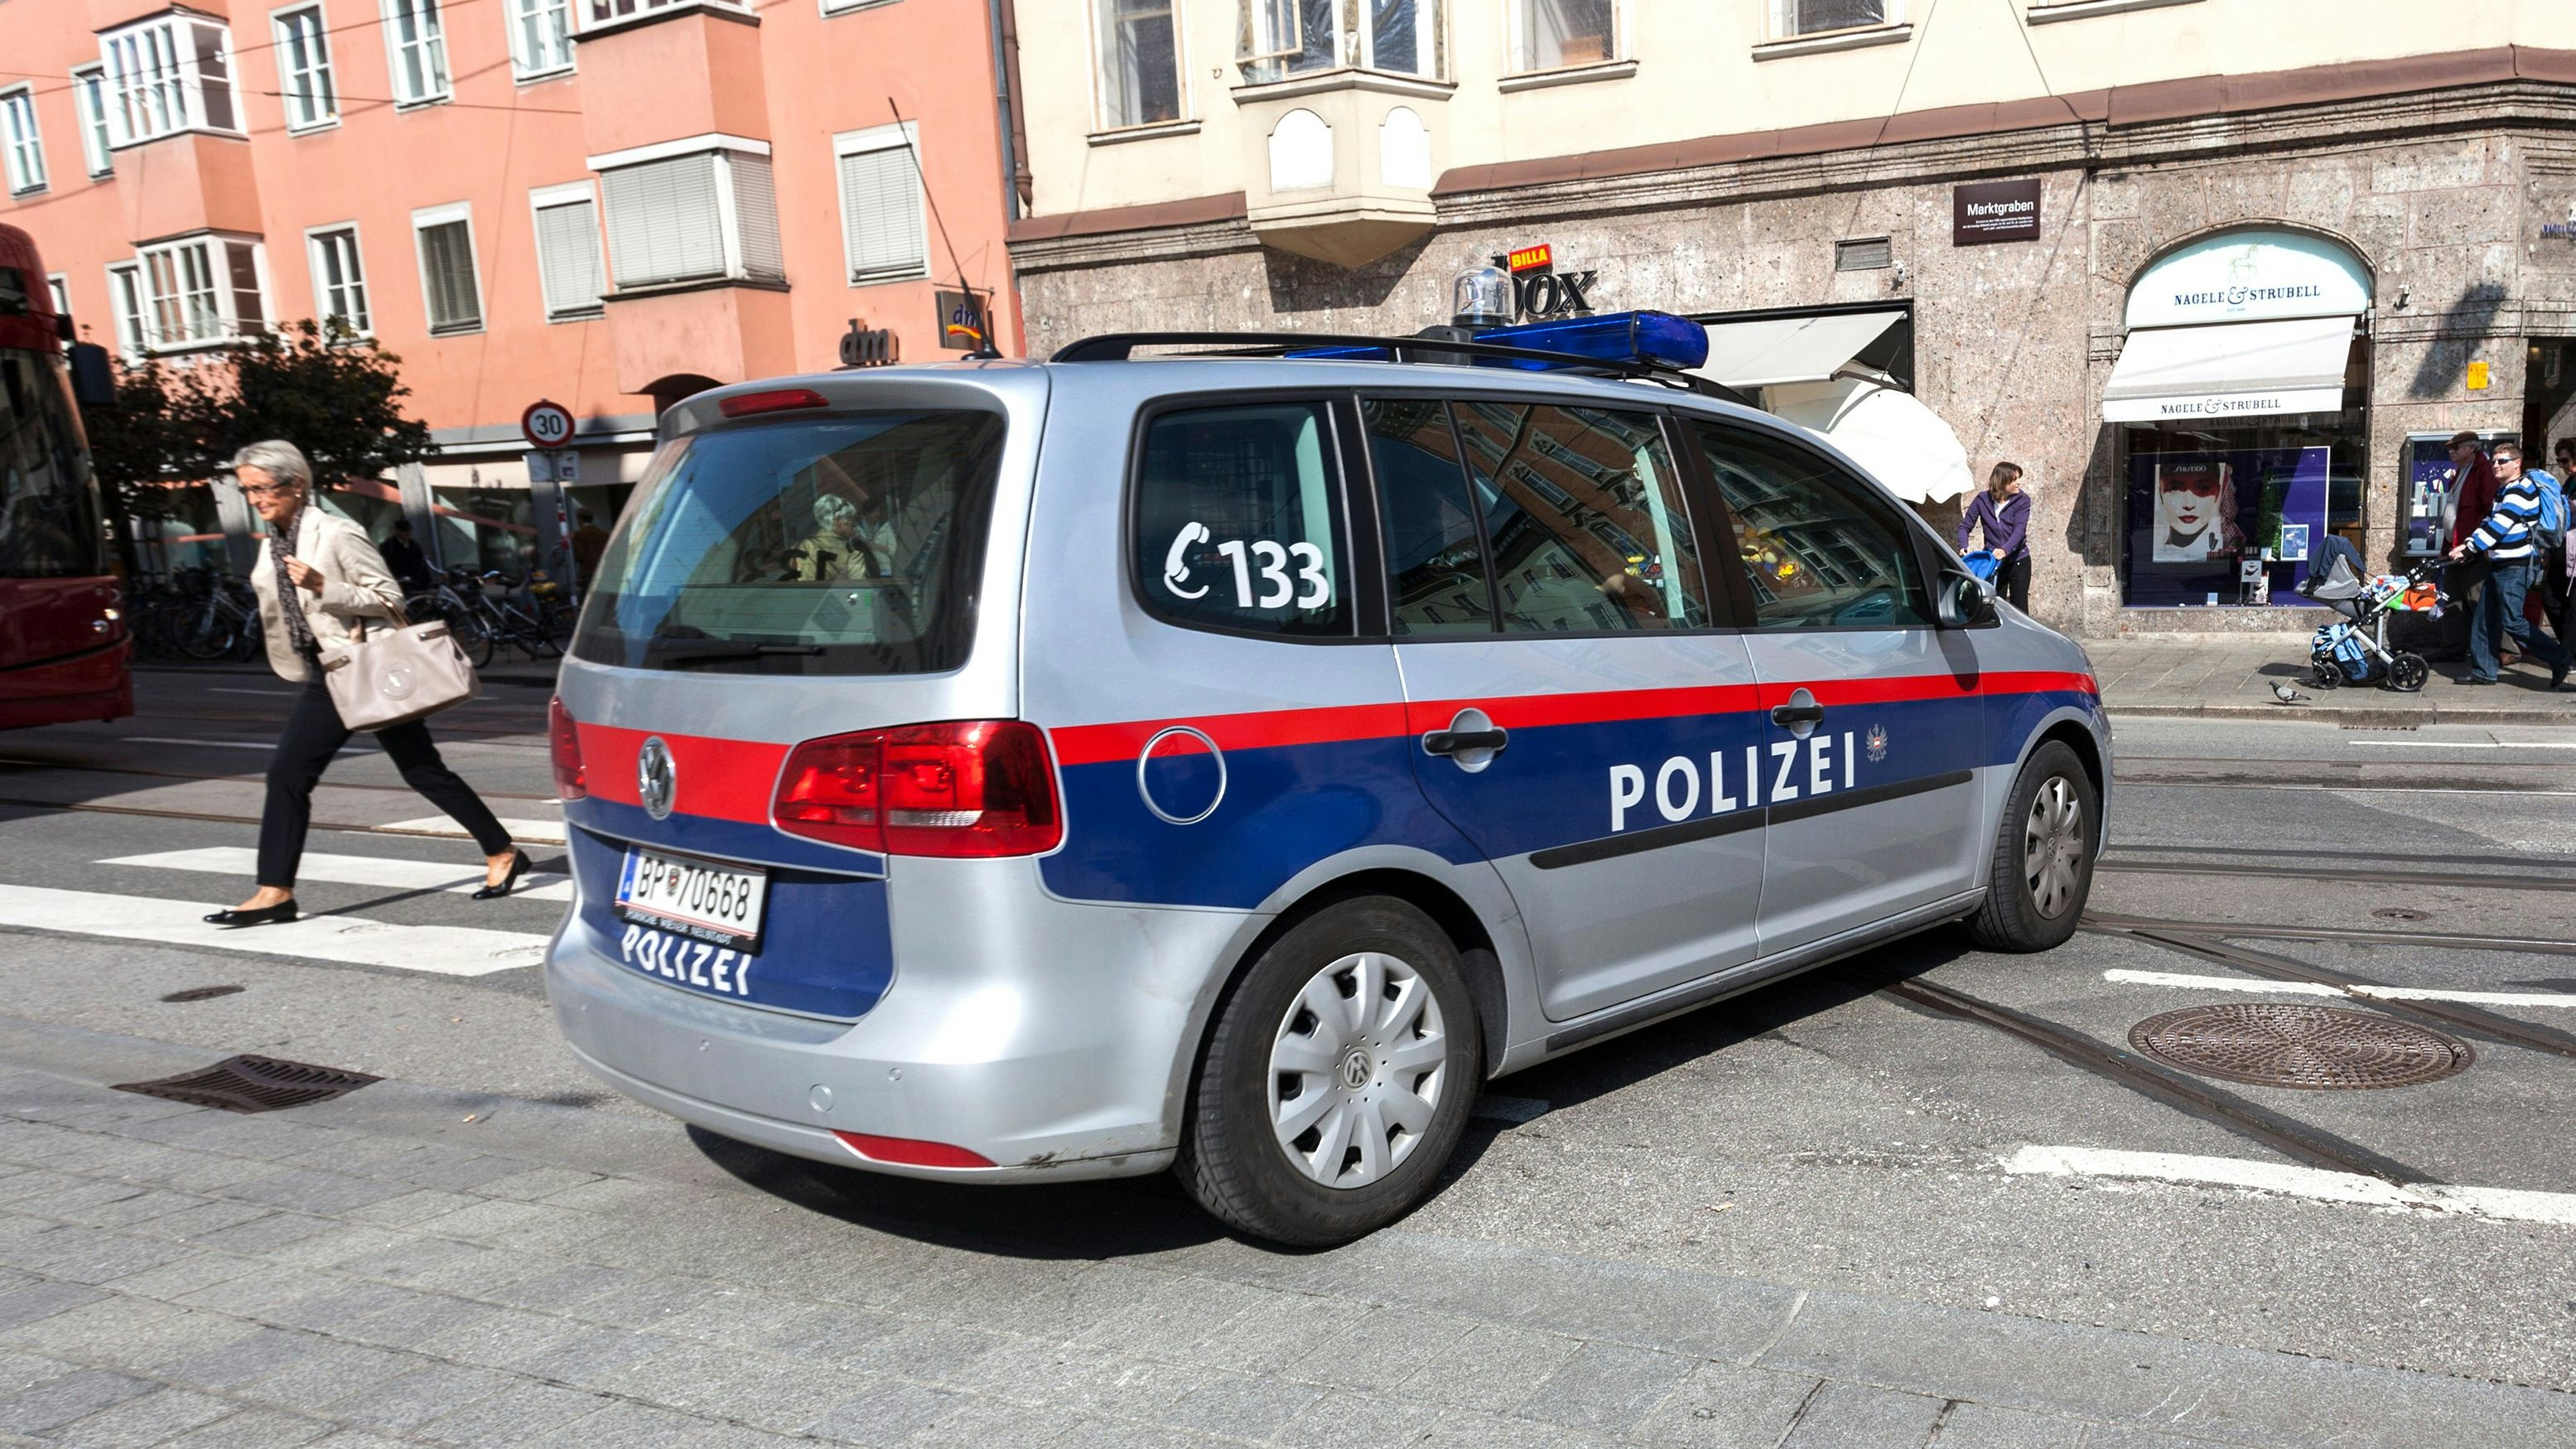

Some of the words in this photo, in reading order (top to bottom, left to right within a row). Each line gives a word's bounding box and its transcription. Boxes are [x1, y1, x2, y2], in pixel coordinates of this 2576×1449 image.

[1967, 200, 2033, 216] Marktgraben
[1512, 249, 1548, 268] BILLA
[2250, 285, 2320, 301] STRUBELL
[2222, 398, 2281, 411] STRUBELL
[535, 414, 562, 435] 30
[1217, 540, 1330, 609] 133
[1609, 731, 1855, 832] POLIZEI
[638, 857, 666, 900] BP
[678, 865, 750, 922] 70668
[621, 924, 752, 996] POLIZEI
